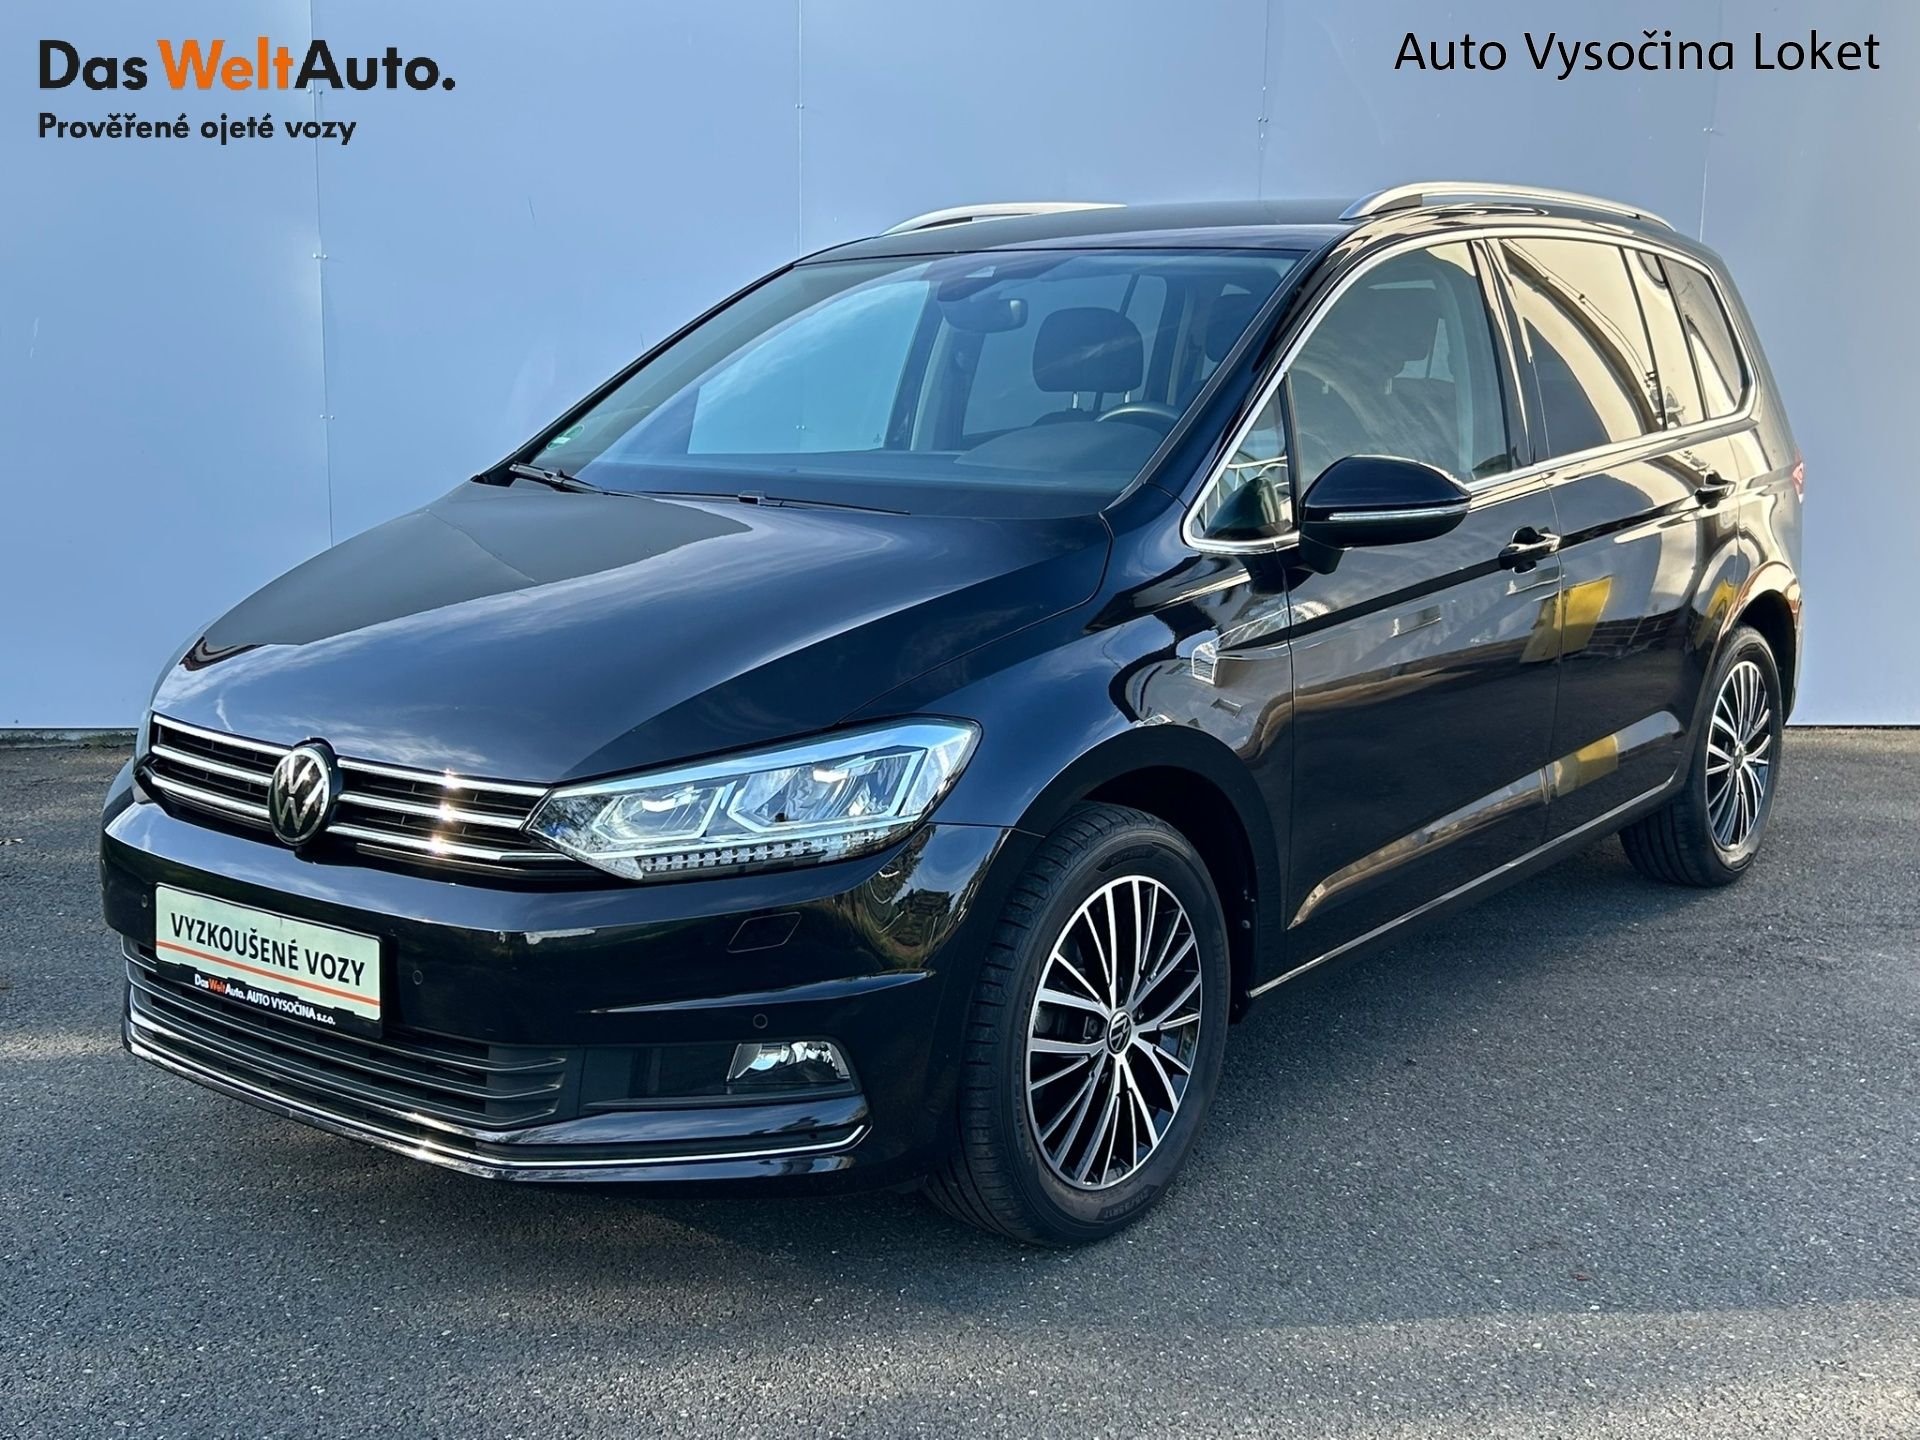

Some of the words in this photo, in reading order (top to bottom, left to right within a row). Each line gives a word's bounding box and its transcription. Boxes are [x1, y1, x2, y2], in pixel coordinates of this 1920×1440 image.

[170, 912, 299, 971] VYZKOUŠENÉ
[304, 948, 365, 986] VOZY
[246, 989, 270, 1007] AUTO
[271, 996, 316, 1020] VYSOČINA
